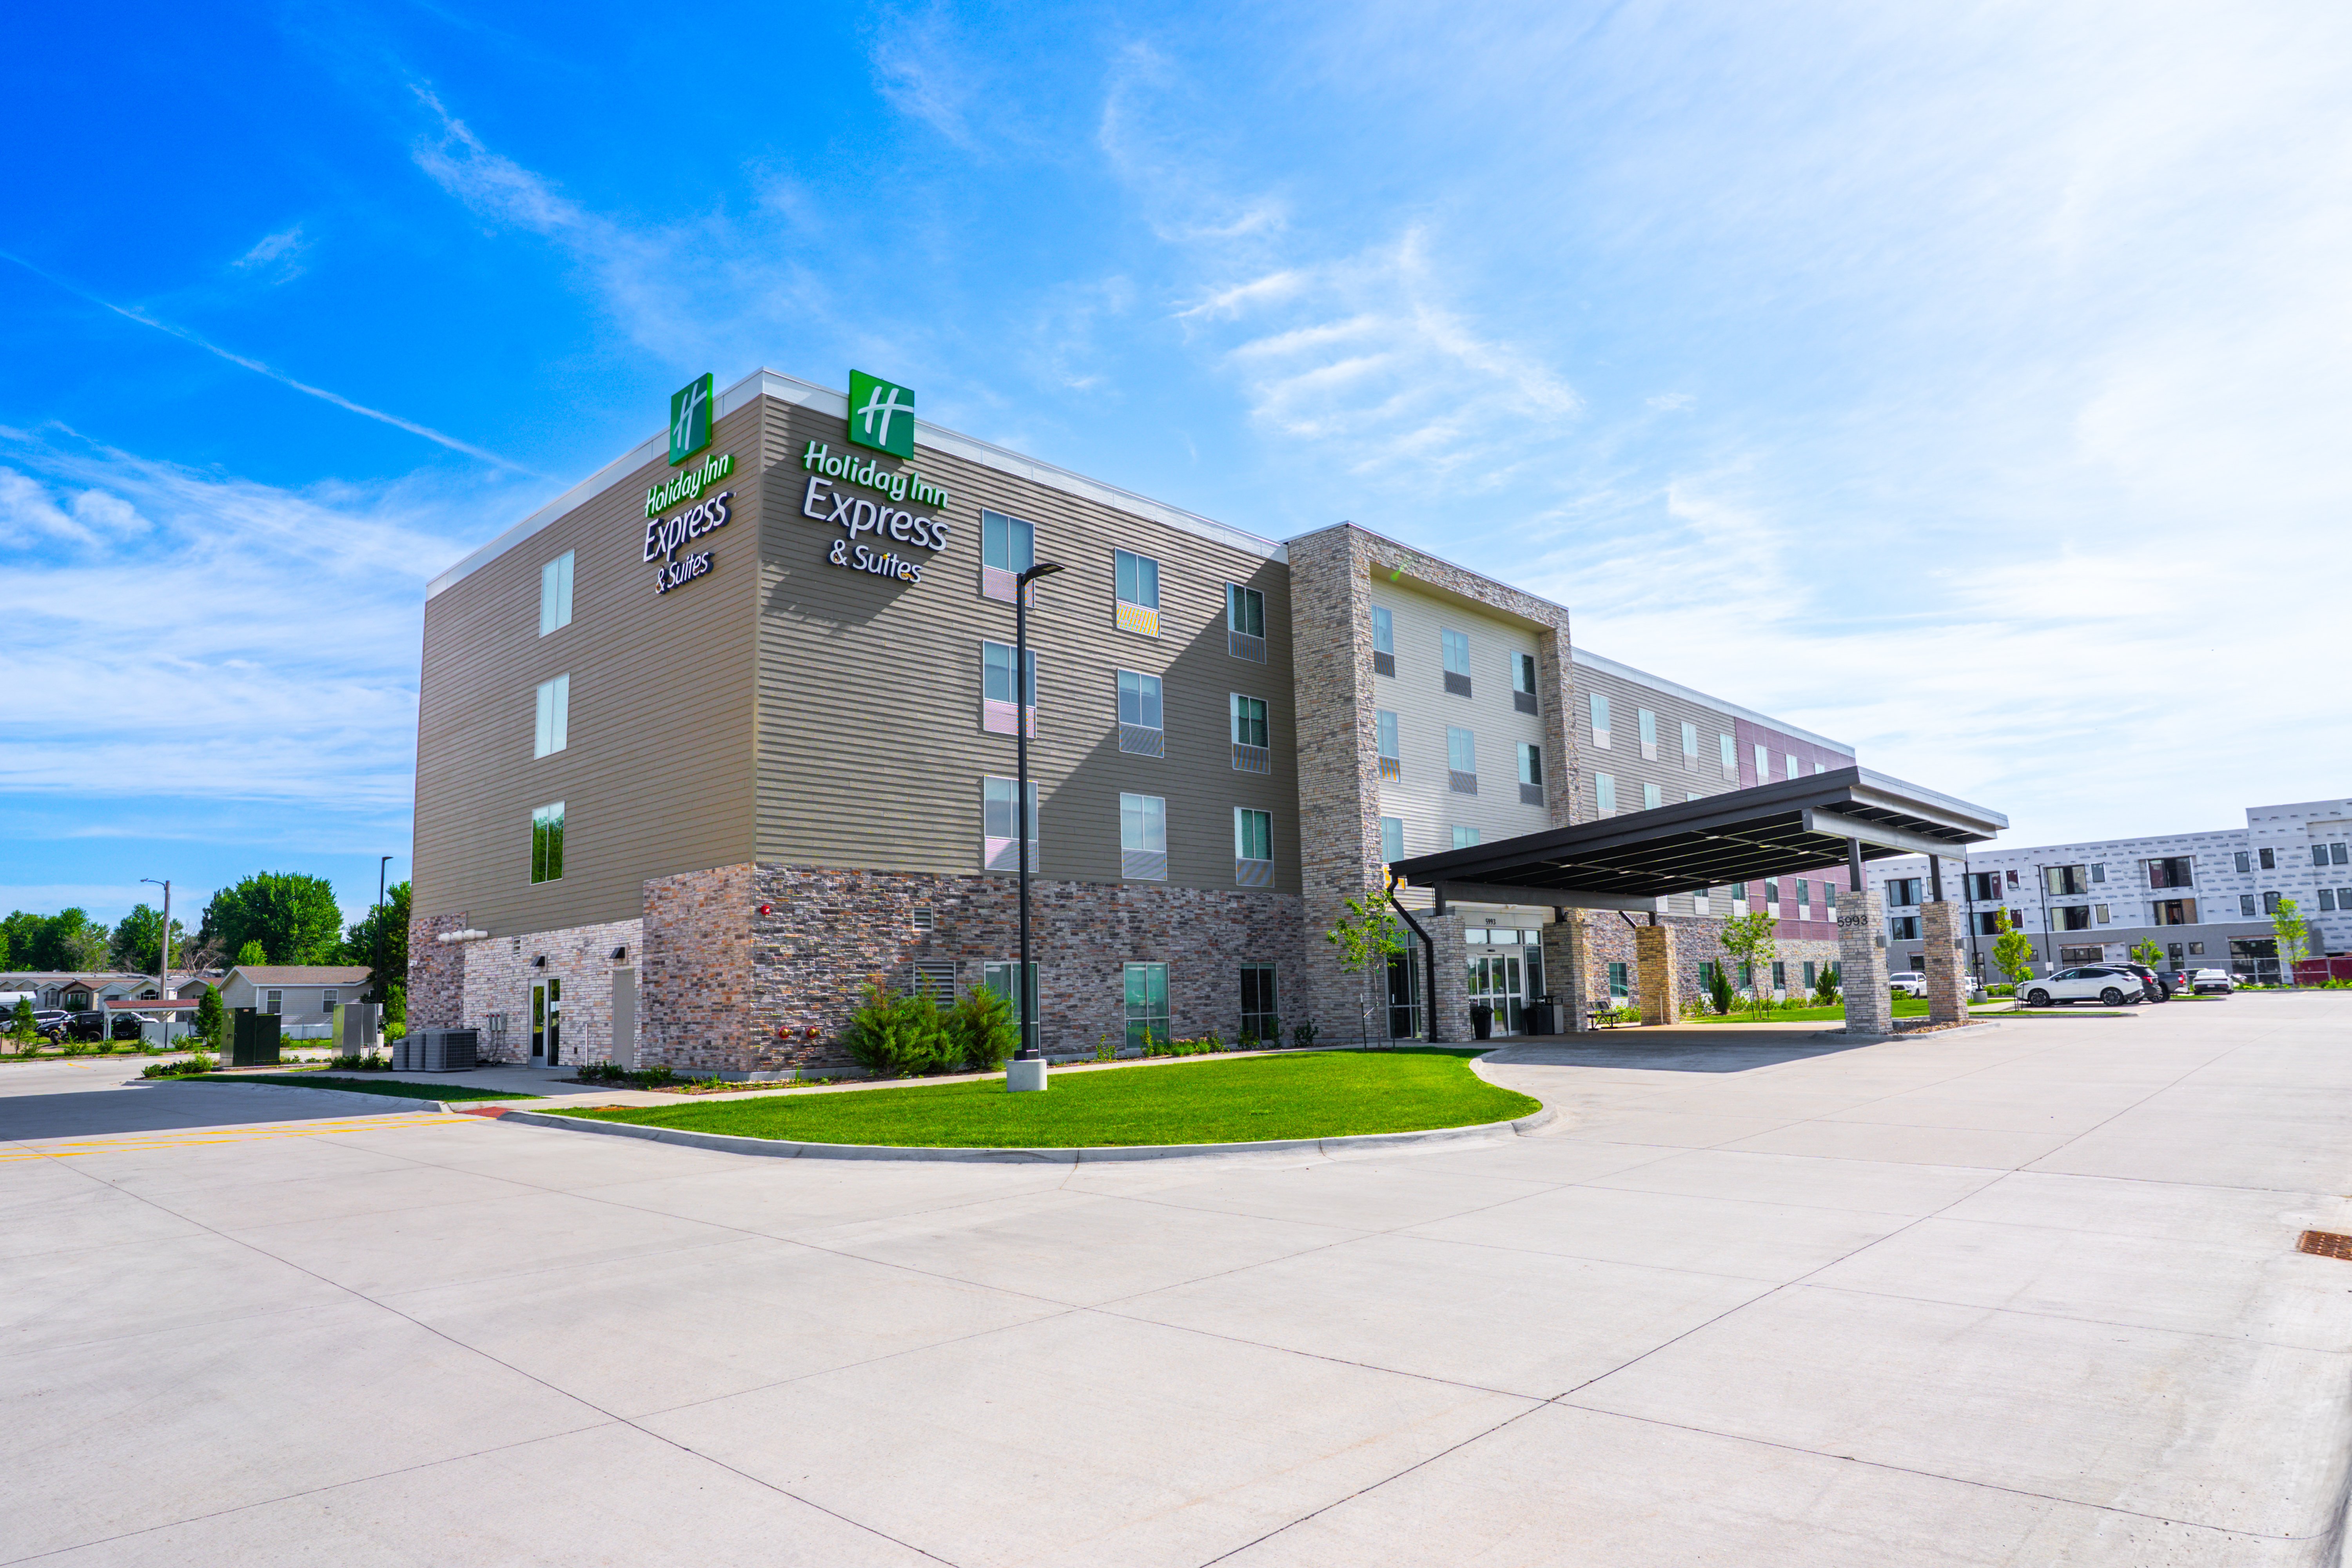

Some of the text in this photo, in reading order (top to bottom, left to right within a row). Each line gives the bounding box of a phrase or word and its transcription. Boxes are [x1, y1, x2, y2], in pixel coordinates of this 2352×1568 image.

[645, 454, 729, 517] Holiday Inn
[804, 440, 949, 508] Holiday Inn
[643, 492, 728, 562] Express
[803, 476, 948, 551] Express
[655, 552, 710, 594] & Suites
[829, 539, 922, 583] & Suites
[1837, 915, 1868, 927] 5993
